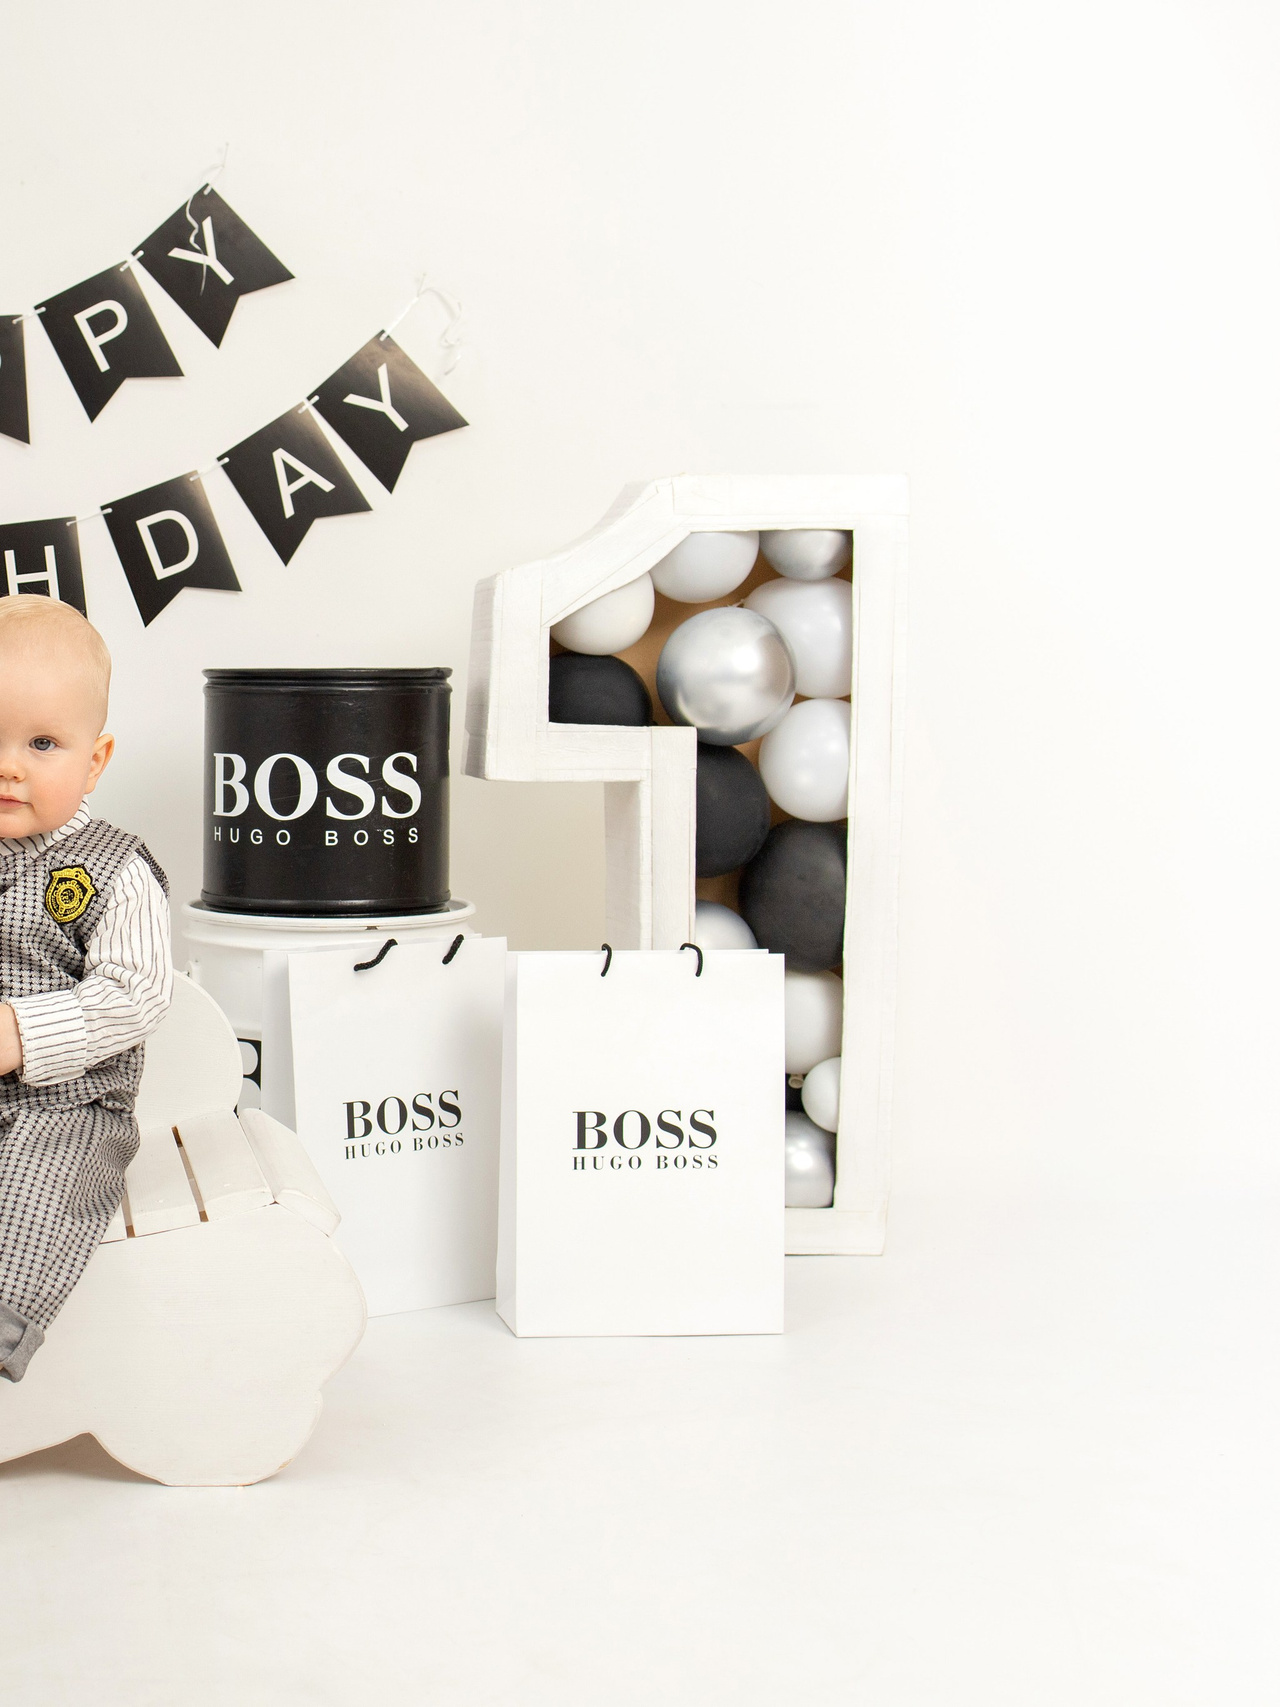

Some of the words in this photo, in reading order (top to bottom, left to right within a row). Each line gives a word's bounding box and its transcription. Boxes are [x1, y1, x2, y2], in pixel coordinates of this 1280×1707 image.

[212, 751, 422, 821] BOSS
[213, 826, 291, 846] HUGO
[325, 827, 419, 847] BOSS
[342, 1089, 463, 1141] BOSS
[572, 1109, 718, 1150] BOSS
[344, 1139, 402, 1160] HUGO
[412, 1132, 464, 1152] BOSS
[572, 1155, 642, 1171] HUGO
[656, 1154, 719, 1170] BOSS
